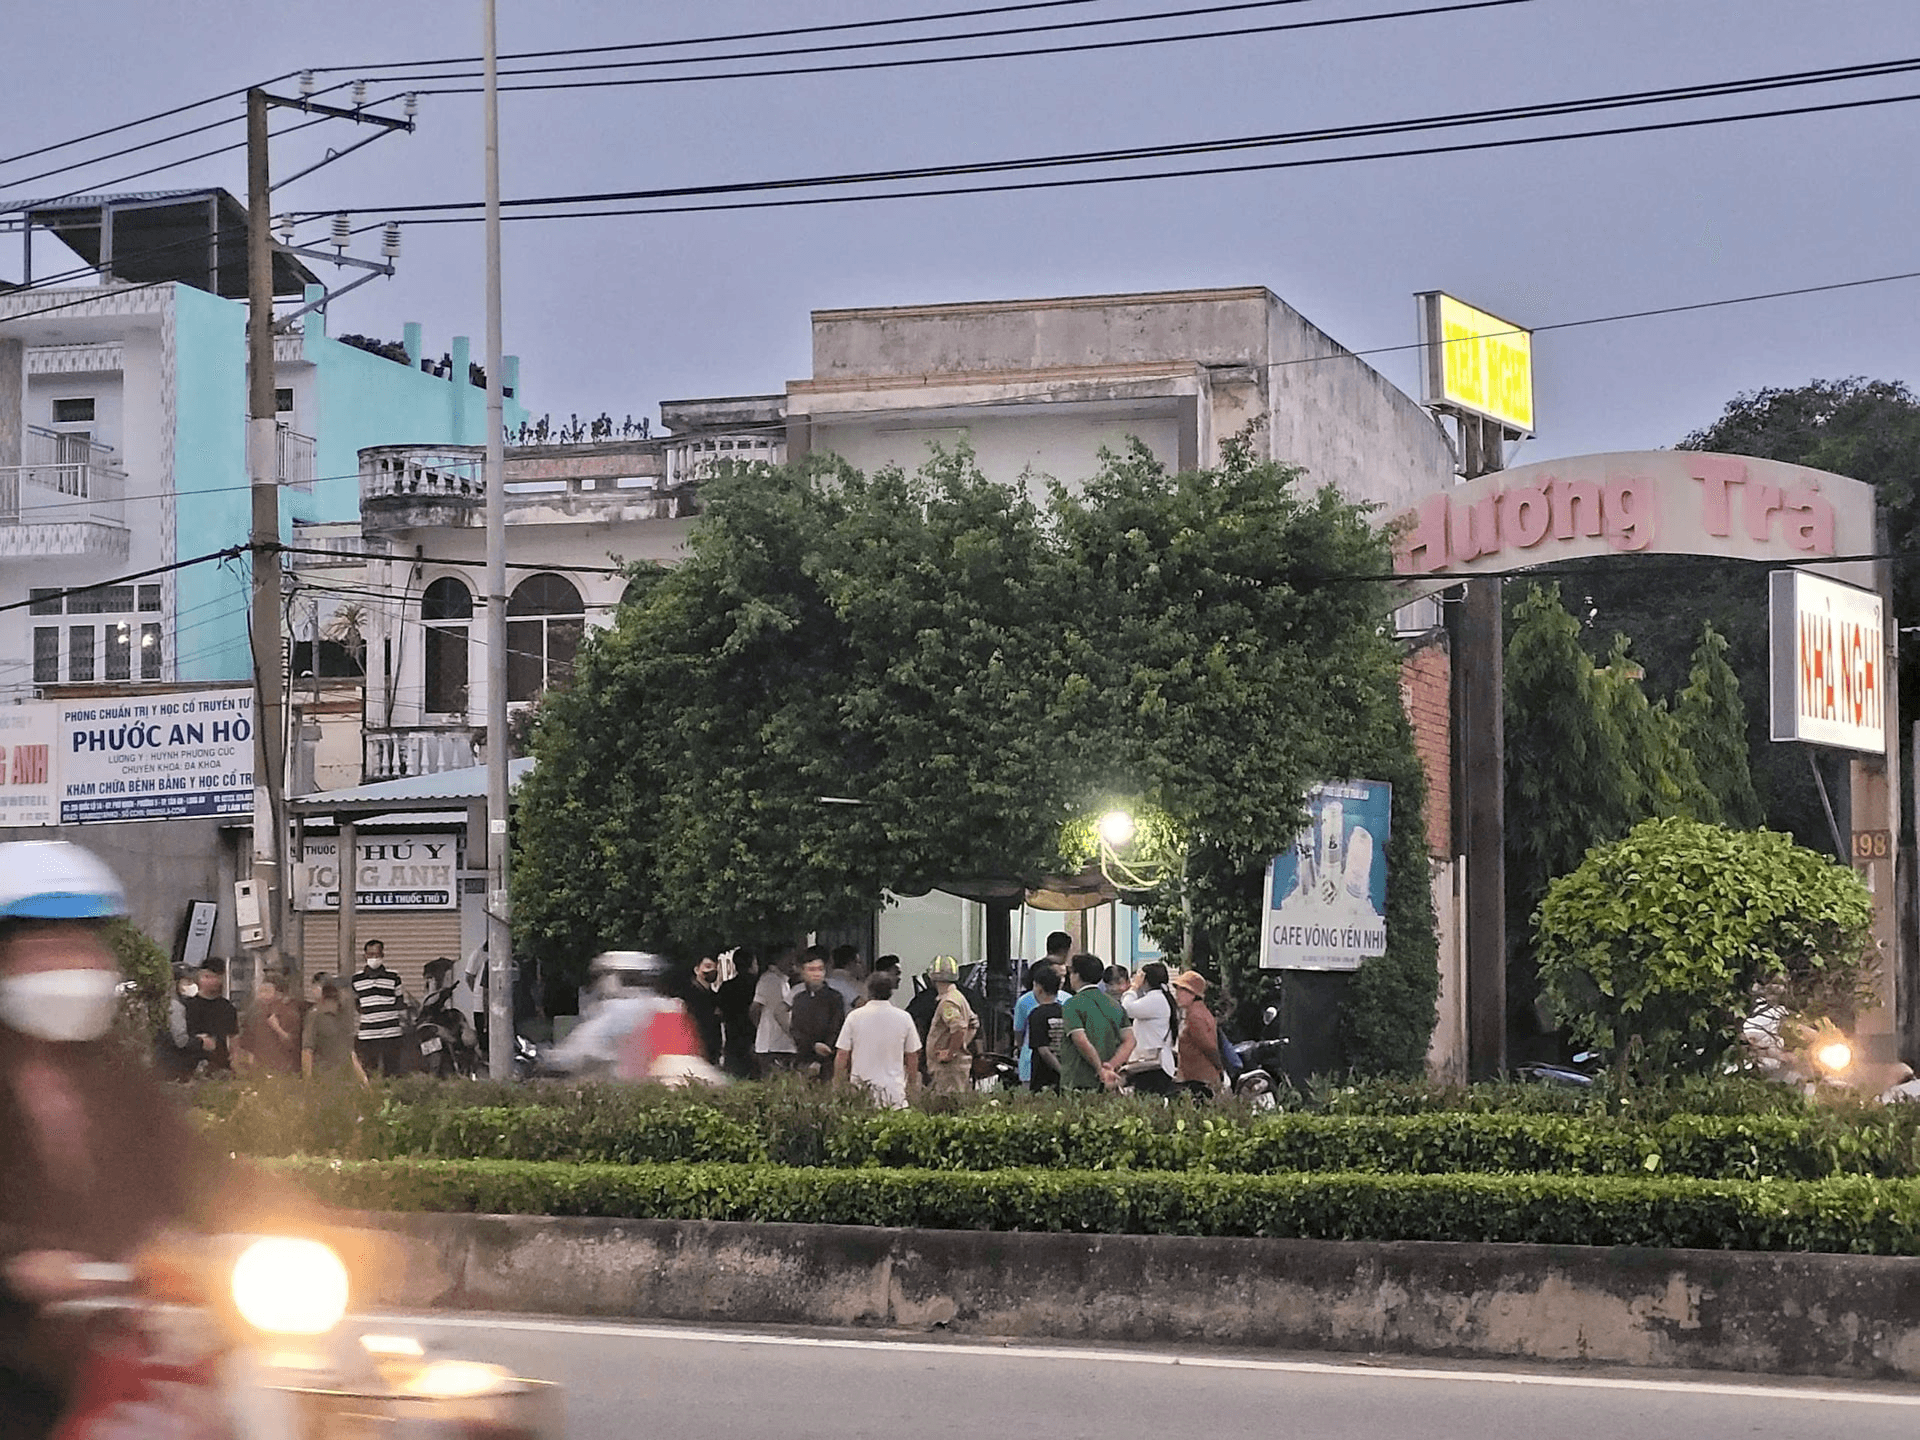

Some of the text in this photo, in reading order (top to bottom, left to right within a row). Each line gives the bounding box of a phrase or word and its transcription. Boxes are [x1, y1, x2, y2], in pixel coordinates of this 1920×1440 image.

[1800, 596, 1836, 722] NHÀ
[152, 704, 157, 716] Y
[160, 703, 179, 717] HỌC
[183, 697, 196, 713] CỔ
[73, 712, 254, 752] PHƯỚC AN HÒ
[11, 744, 48, 784] ANH
[198, 760, 221, 769] KHOA
[190, 776, 196, 788] Y
[199, 774, 219, 790] HỌC
[222, 768, 237, 786] CỔ
[356, 839, 446, 860] HÚ Y
[388, 865, 450, 886] ANH
[395, 892, 422, 904] THUỐC
[423, 892, 440, 904] THÚ
[442, 895, 448, 903] Y
[1273, 925, 1302, 946] CAFE
[1363, 929, 1384, 949] NHI
